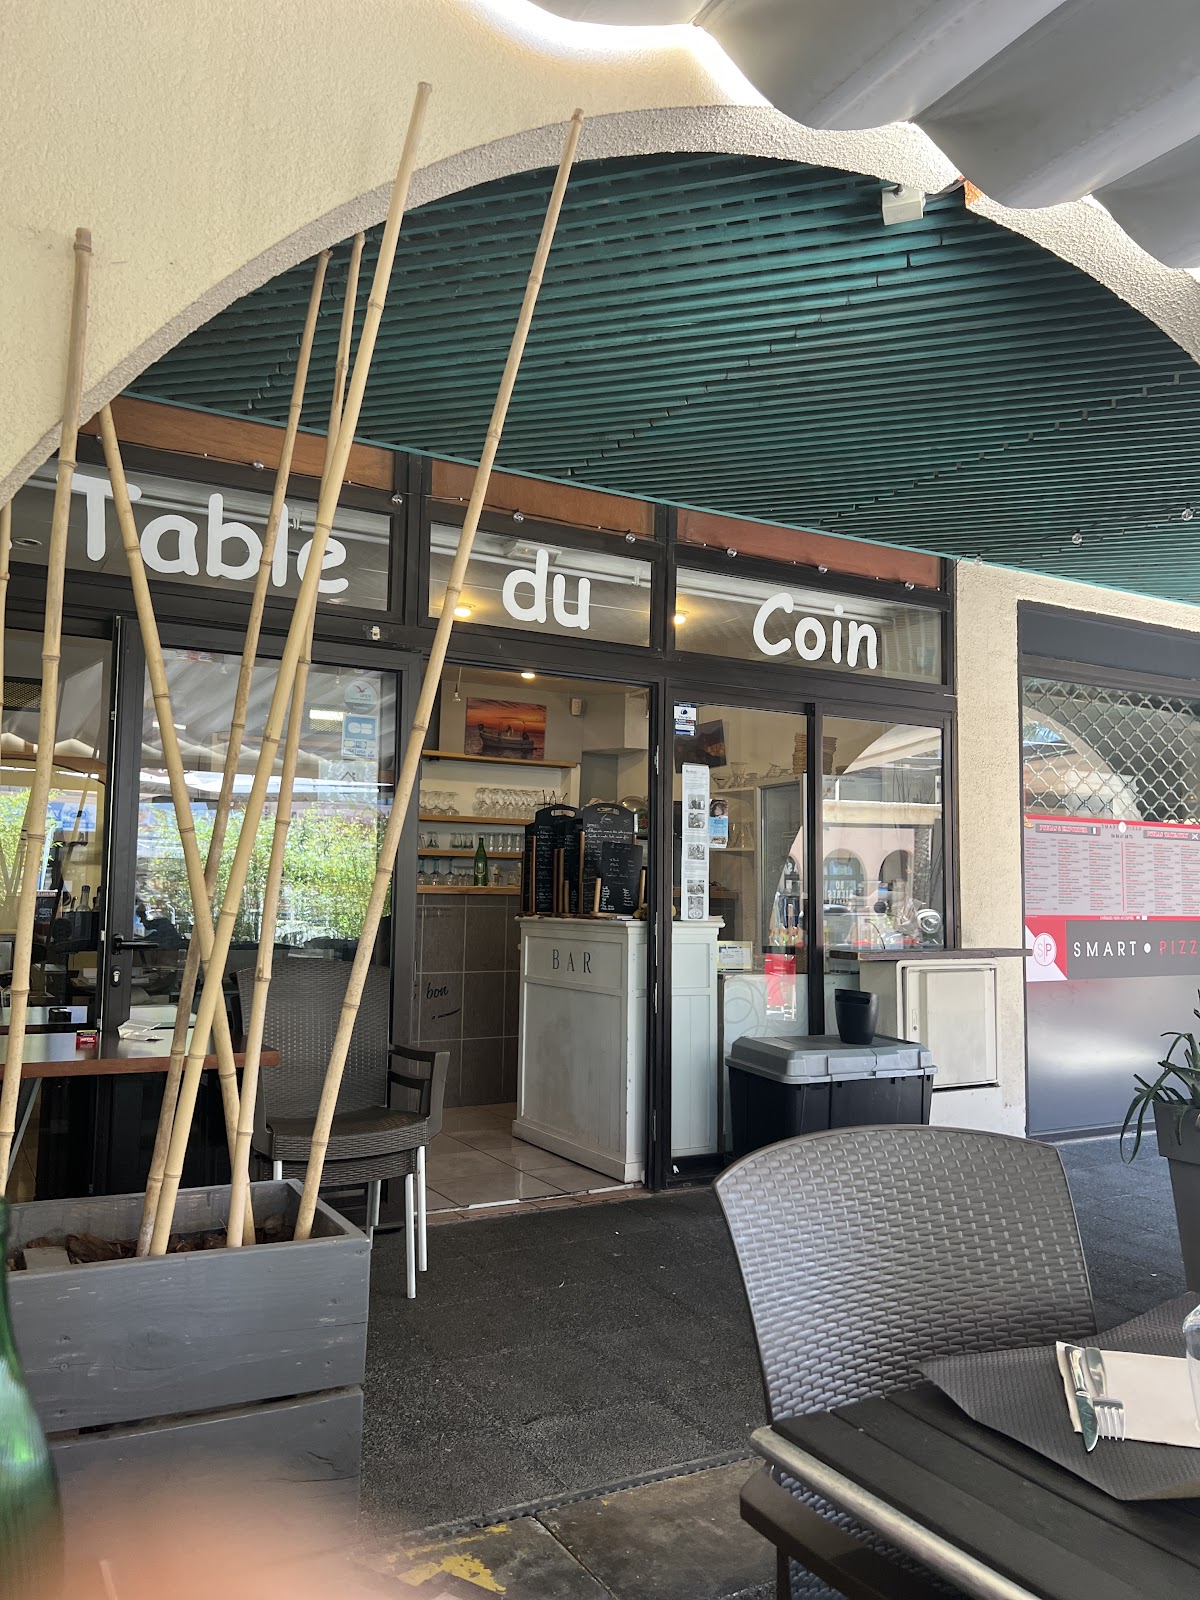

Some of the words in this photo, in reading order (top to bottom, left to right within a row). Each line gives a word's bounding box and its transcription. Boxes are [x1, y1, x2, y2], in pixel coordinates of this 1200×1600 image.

[56, 472, 349, 594] Table
[502, 549, 592, 630] du
[753, 592, 878, 671] Coin
[1073, 940, 1137, 958] SMART
[551, 948, 593, 975] BAR
[426, 982, 449, 999] bon
